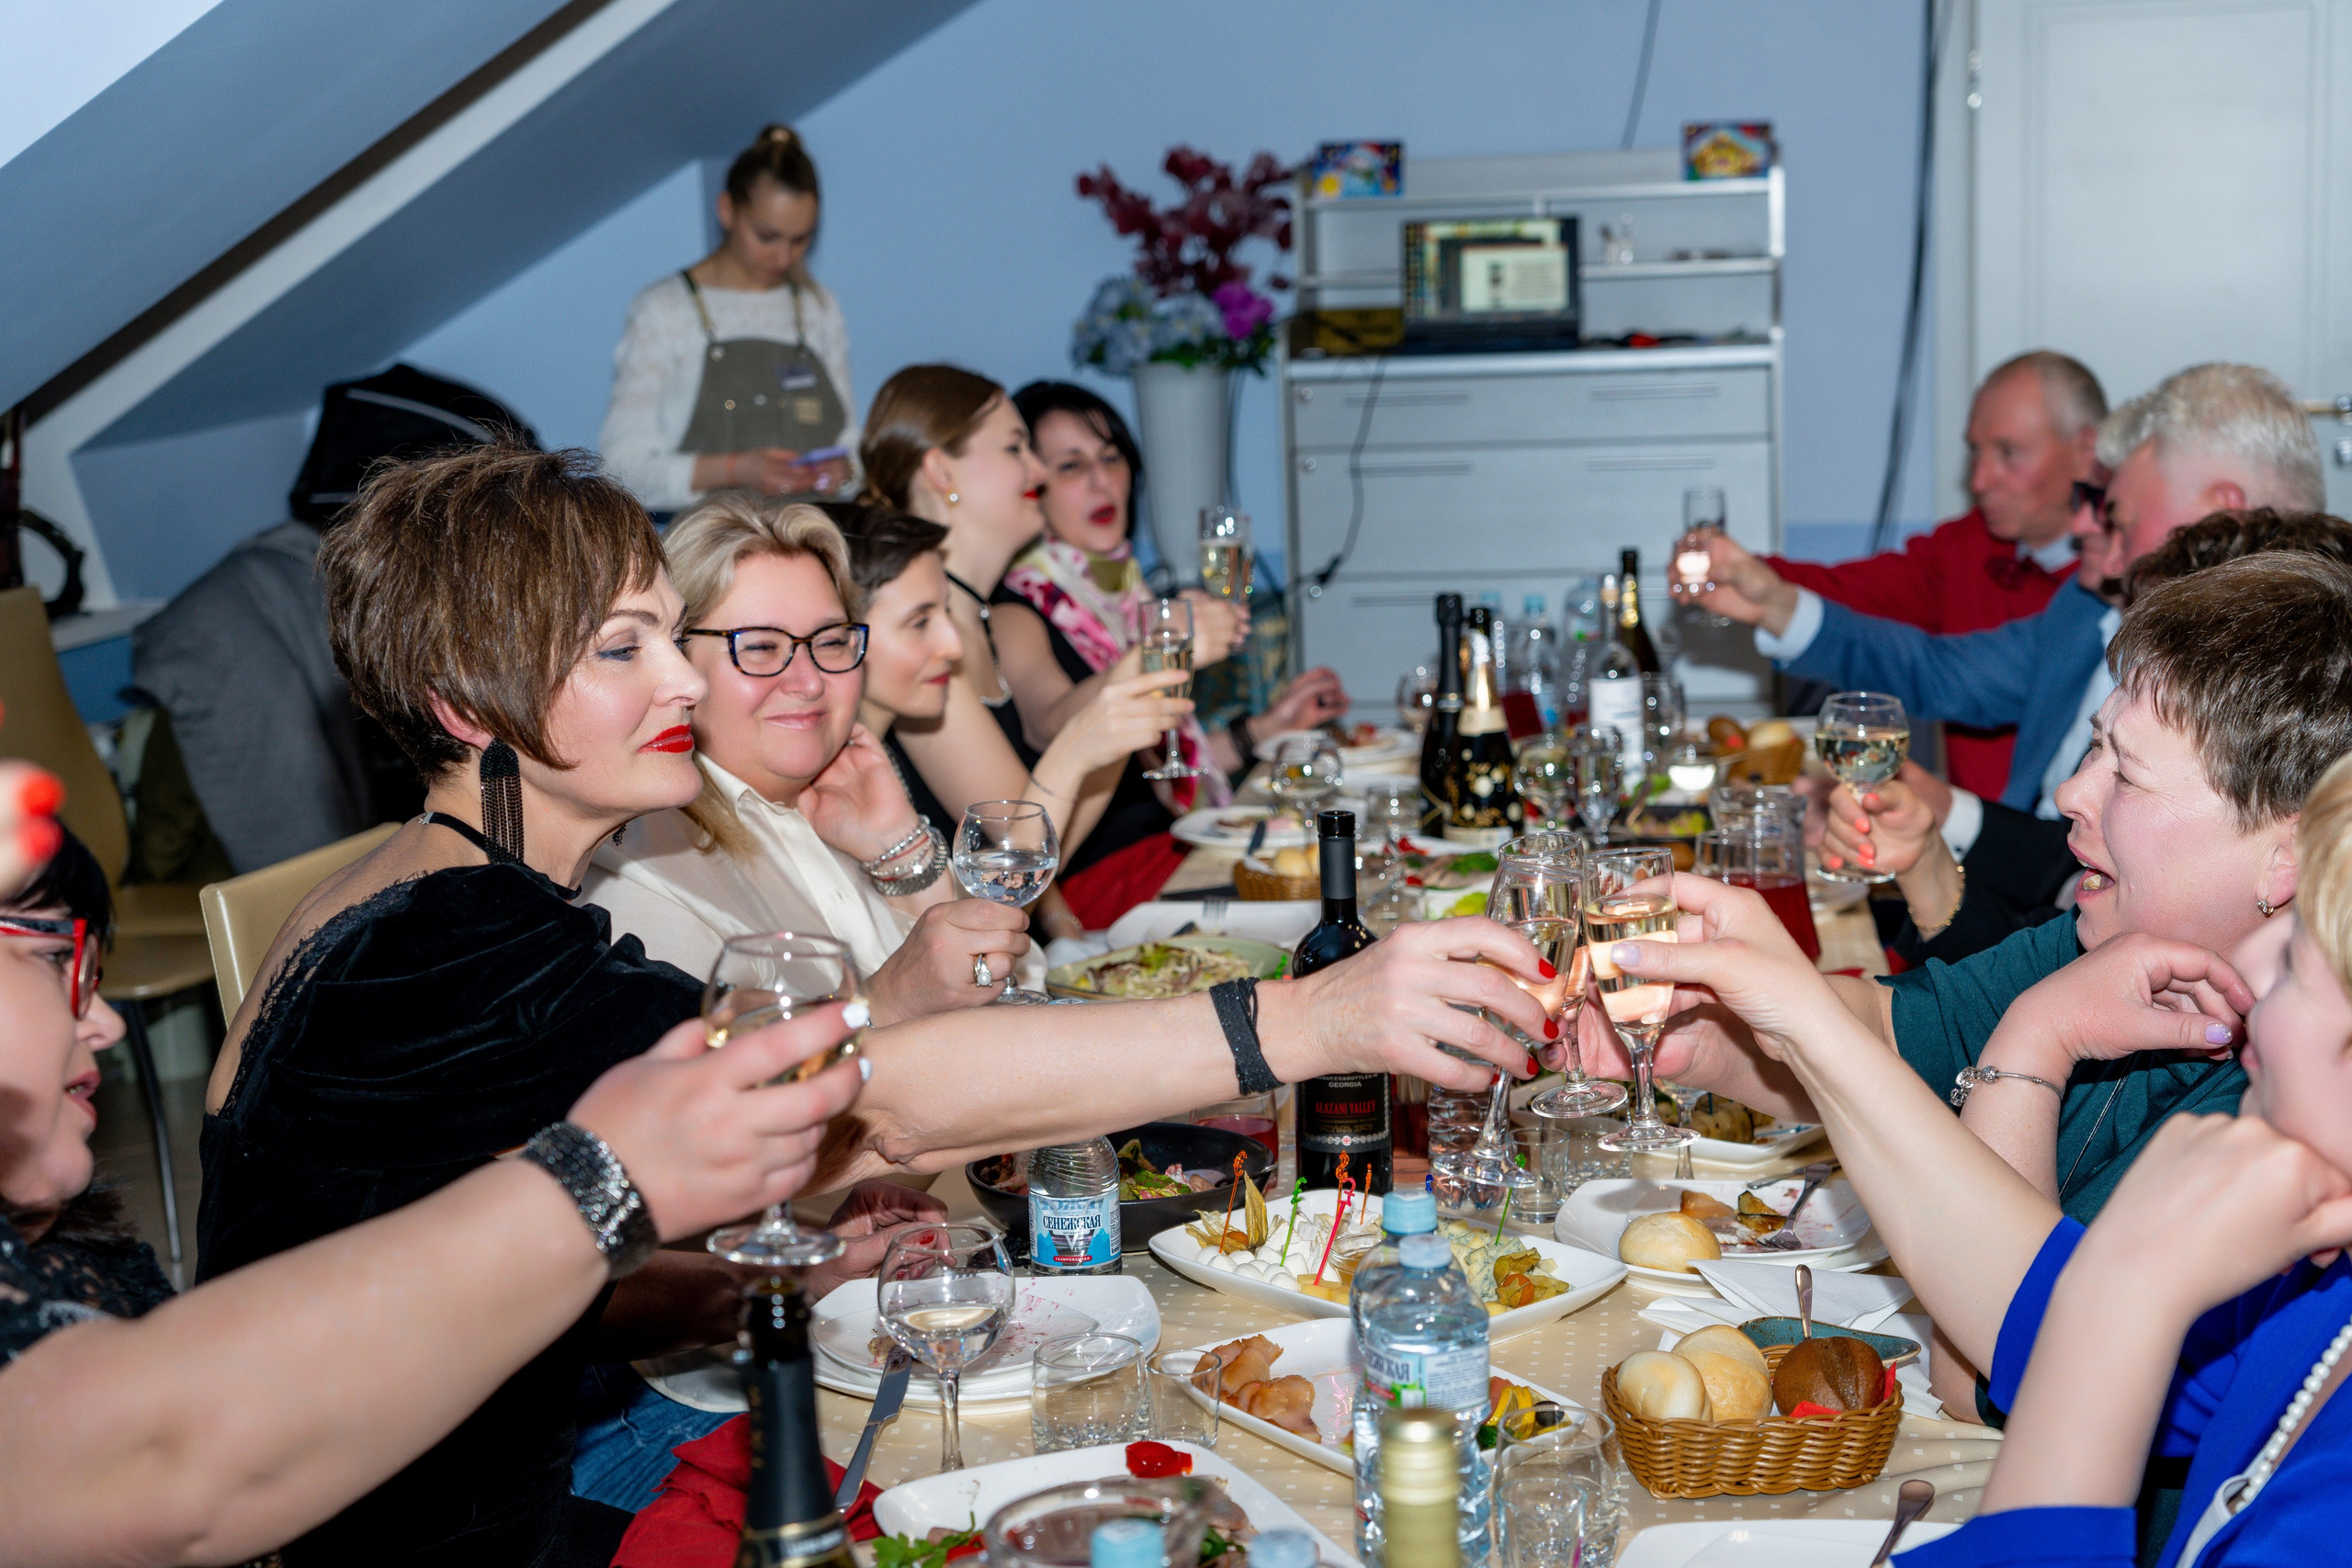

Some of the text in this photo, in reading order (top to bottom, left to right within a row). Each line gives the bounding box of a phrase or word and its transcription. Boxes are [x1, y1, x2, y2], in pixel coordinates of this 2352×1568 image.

[1316, 1100, 1375, 1115] ALAZANI VALLEY
[1043, 1214, 1101, 1230] СЕНЕЖСКАЯ
